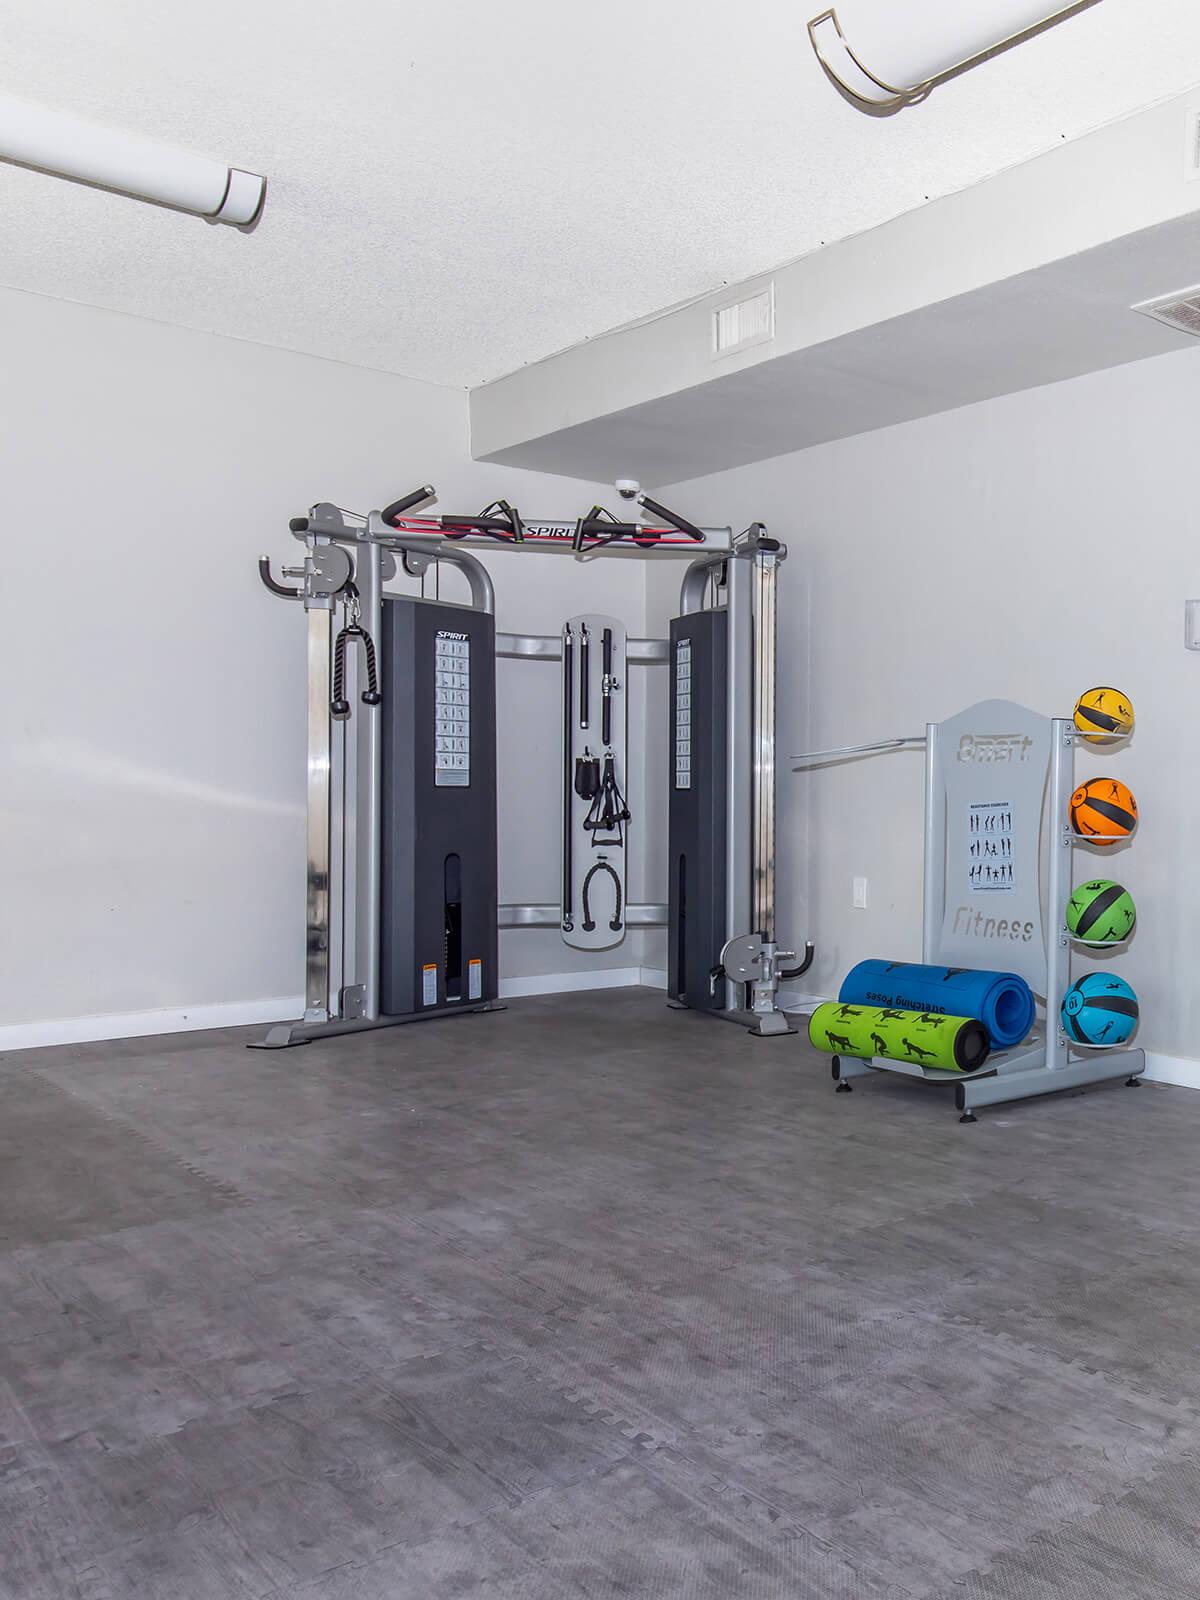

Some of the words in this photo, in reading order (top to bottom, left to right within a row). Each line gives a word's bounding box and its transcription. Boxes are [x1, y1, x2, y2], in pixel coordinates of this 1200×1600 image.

[527, 526, 575, 537] SPIRI
[437, 630, 469, 641] SPIRIT
[953, 906, 1034, 942] Fitness
[865, 991, 894, 1006] Poses
